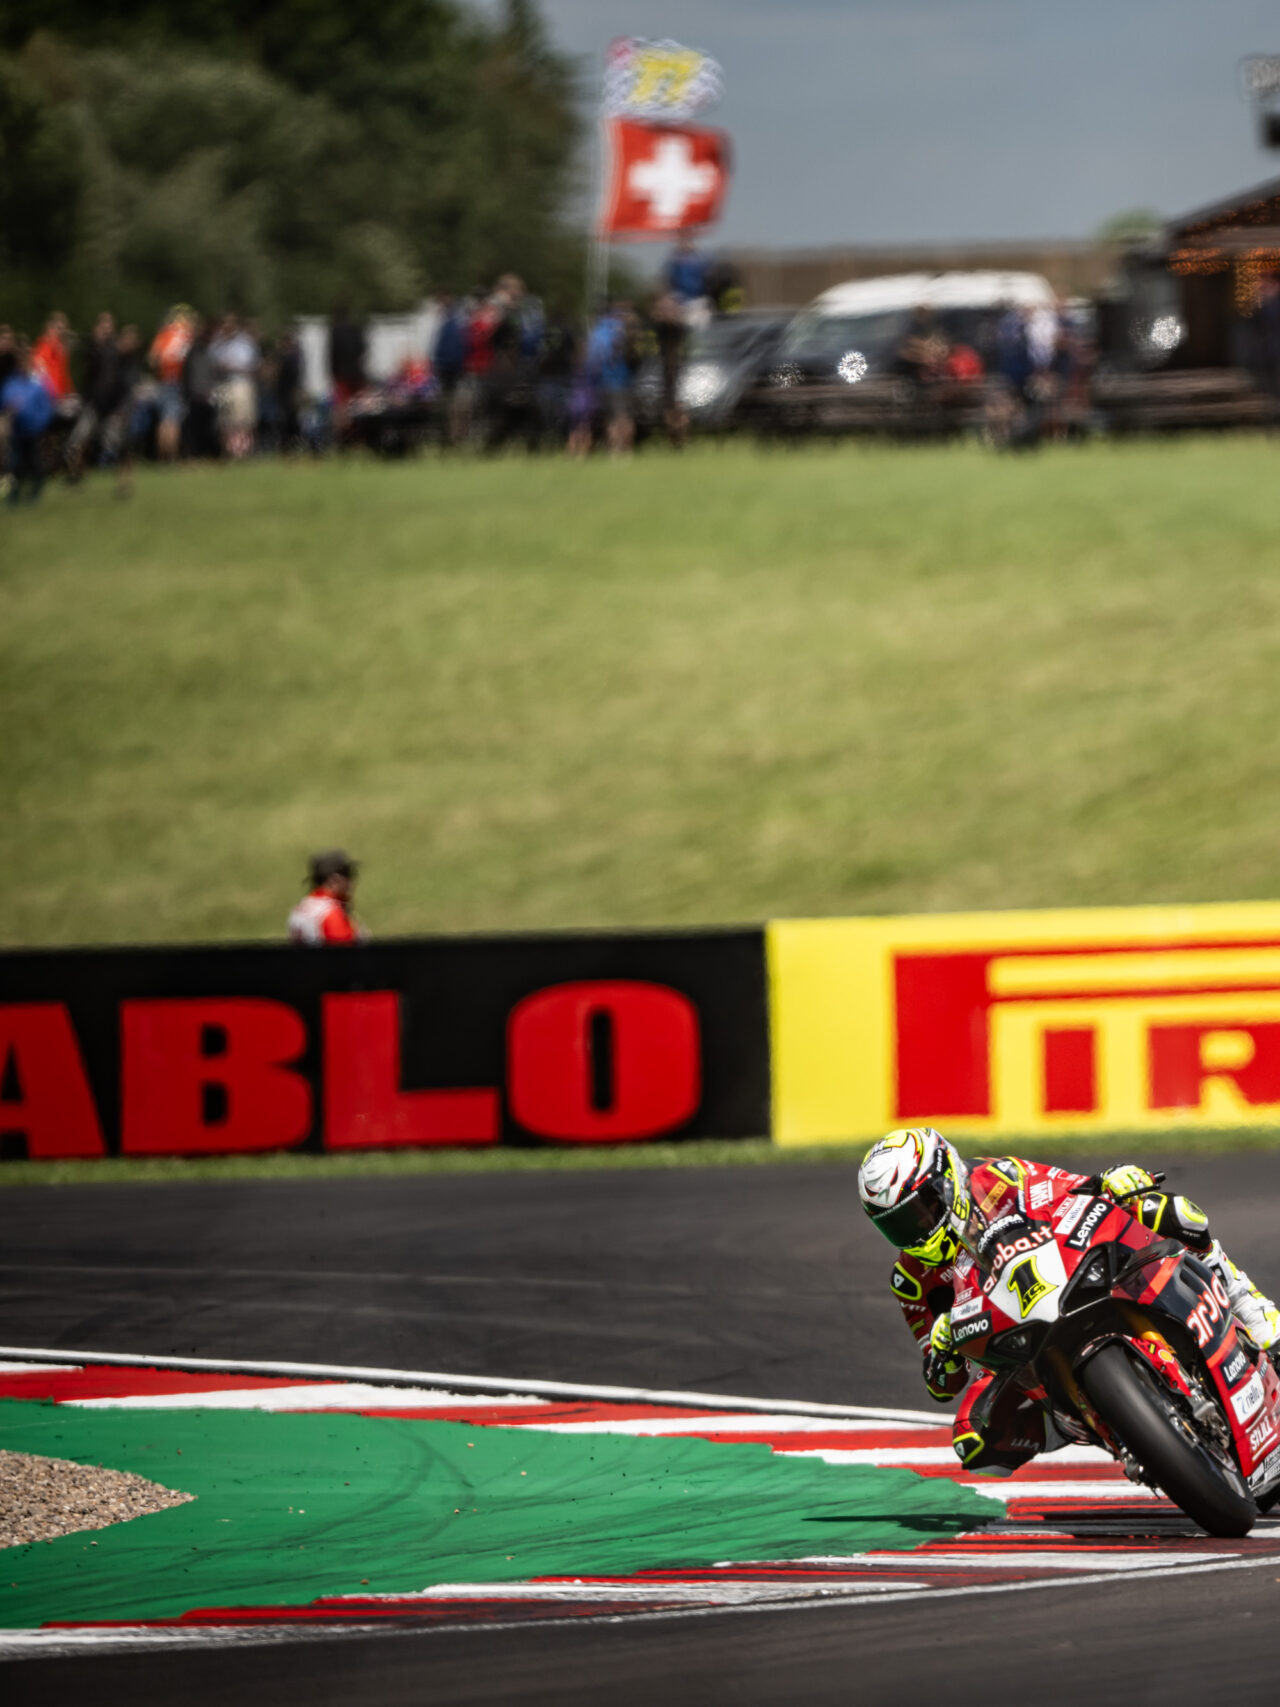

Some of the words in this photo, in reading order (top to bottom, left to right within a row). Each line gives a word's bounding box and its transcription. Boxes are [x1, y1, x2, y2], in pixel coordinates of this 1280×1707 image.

[0, 978, 700, 1160] ABLO
[1070, 1202, 1107, 1247] Lenovo
[983, 1226, 1053, 1293] aruba.it
[1007, 1255, 1059, 1319] 1
[953, 1319, 989, 1342] Lenovo
[1223, 1350, 1247, 1383] Lenovo
